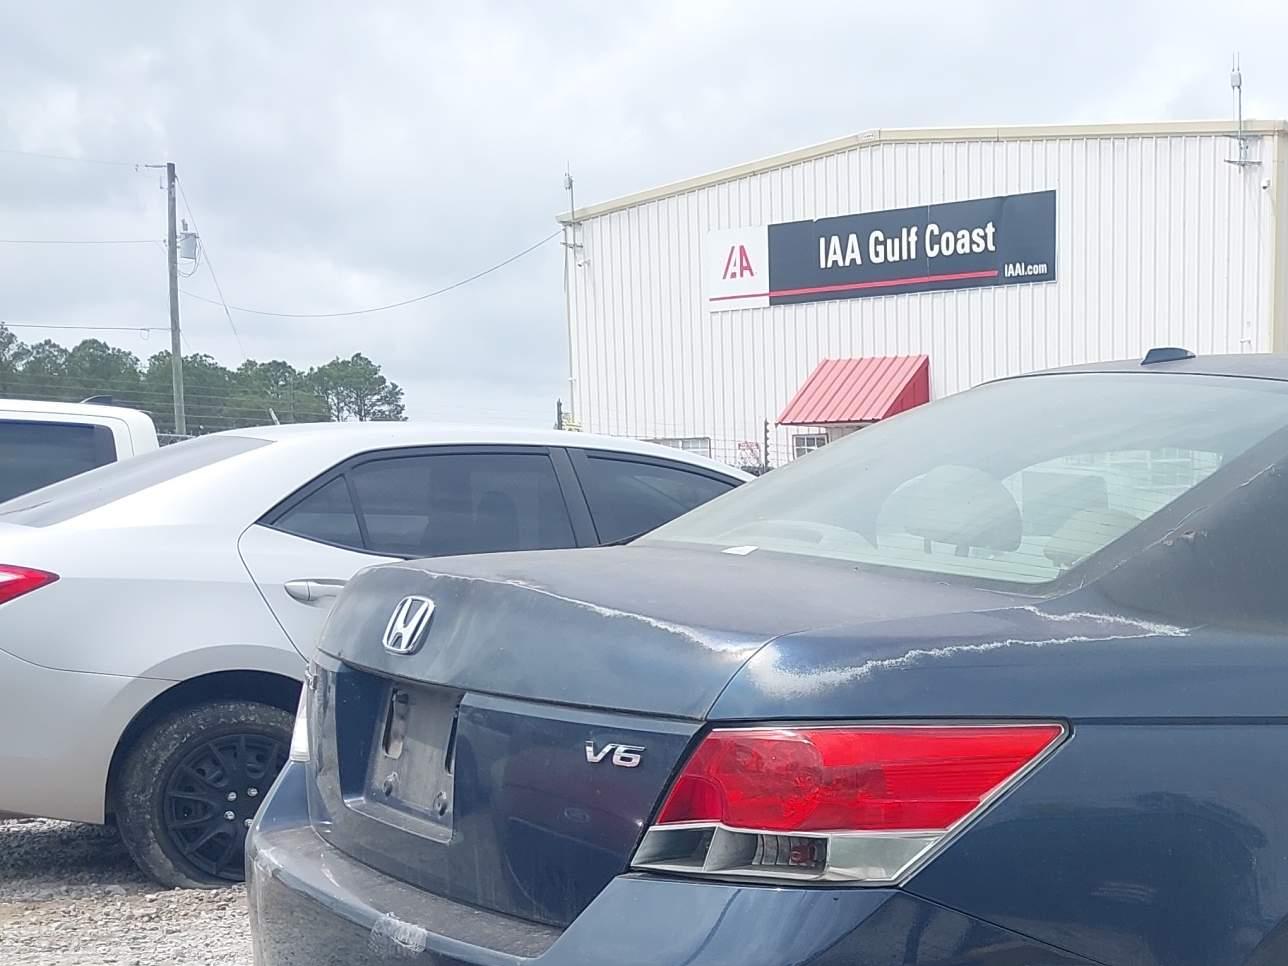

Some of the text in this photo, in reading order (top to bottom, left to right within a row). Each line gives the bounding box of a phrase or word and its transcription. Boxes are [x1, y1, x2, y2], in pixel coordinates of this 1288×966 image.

[819, 221, 996, 269] IAA Gulf Coast
[1004, 262, 1048, 278] IAAI.com
[585, 740, 647, 768] V6
